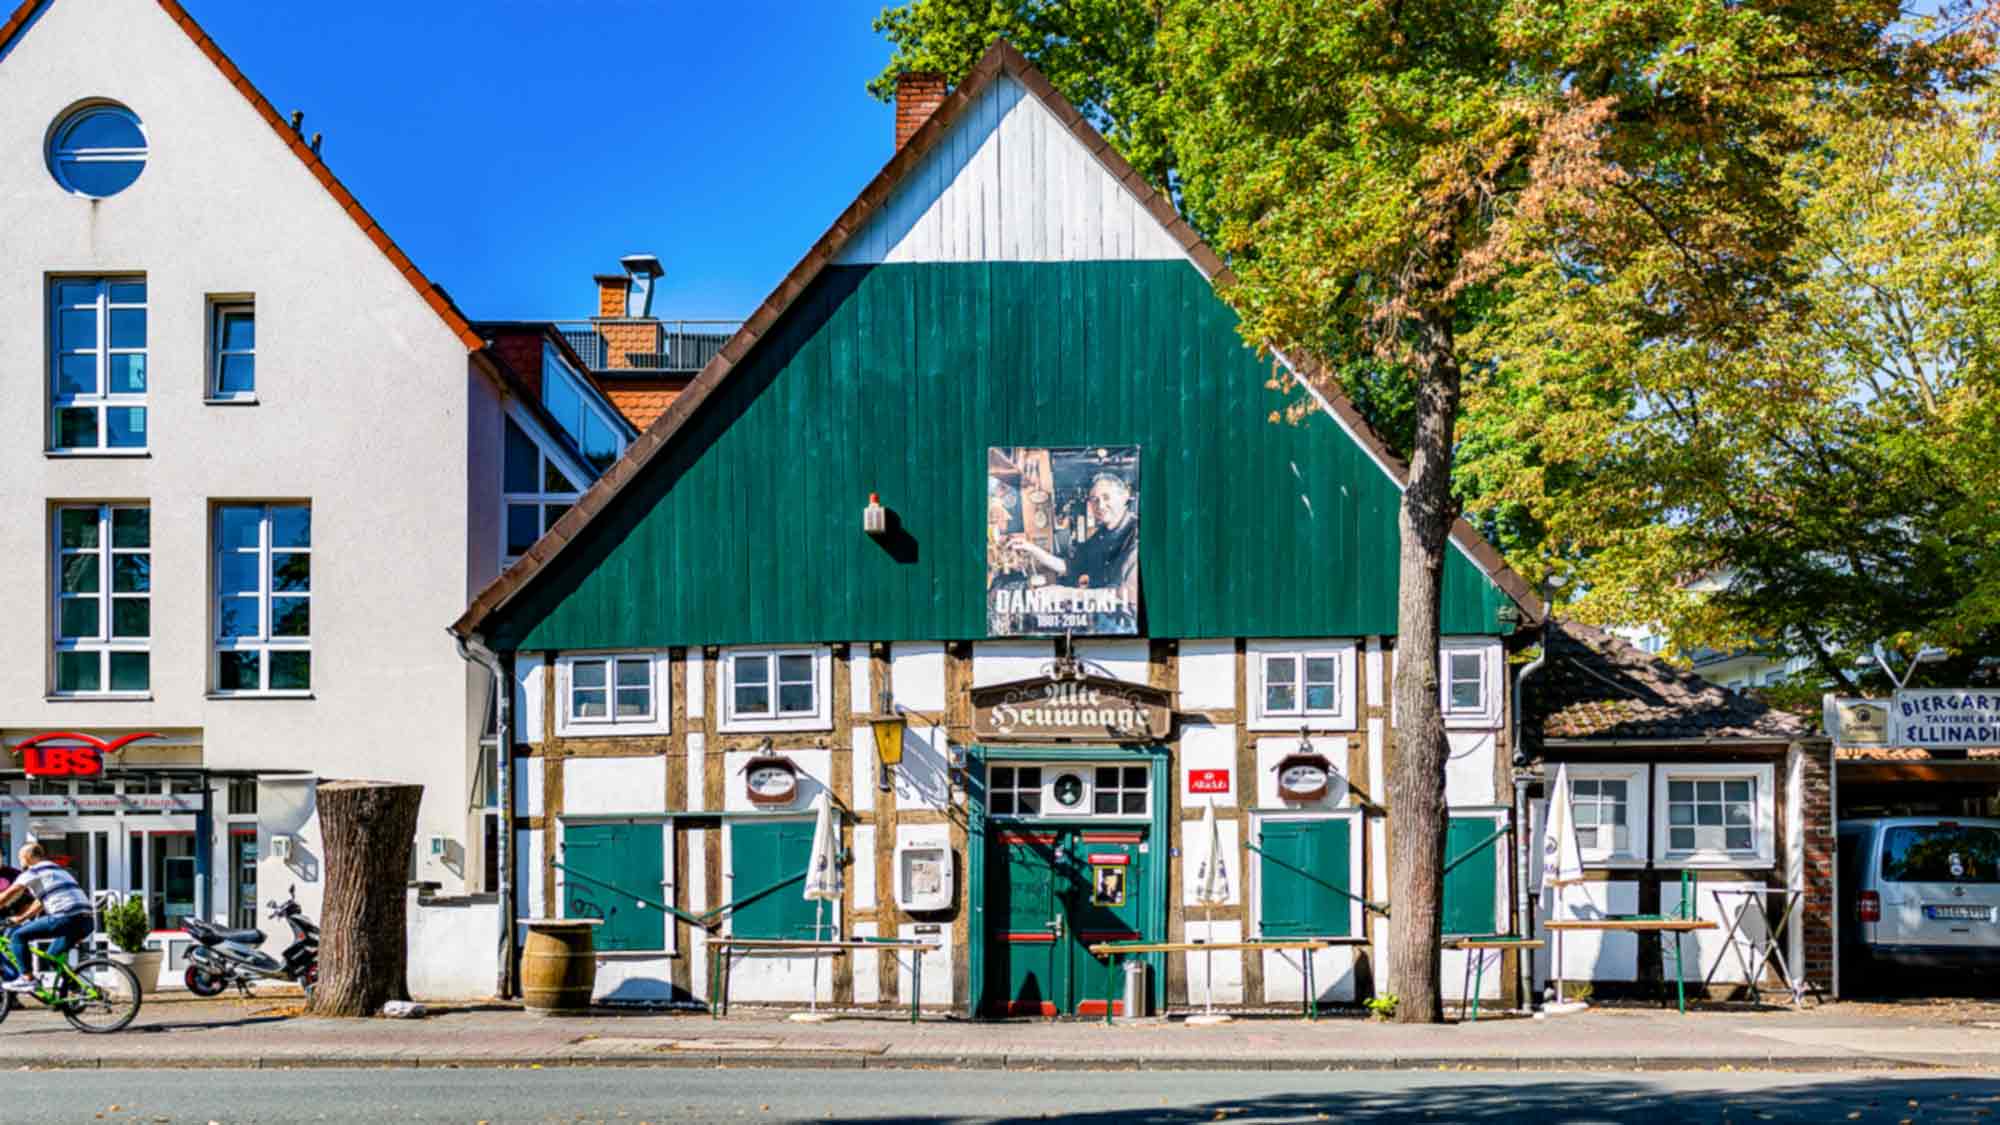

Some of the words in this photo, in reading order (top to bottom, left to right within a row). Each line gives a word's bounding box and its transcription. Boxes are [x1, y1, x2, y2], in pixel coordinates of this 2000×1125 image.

[996, 589, 1065, 613] DANKE
[1045, 681, 1100, 705] Alte
[990, 704, 1151, 734] Heuwaage
[1906, 725, 2000, 743] ELLINADI
[24, 747, 100, 776] LBS
